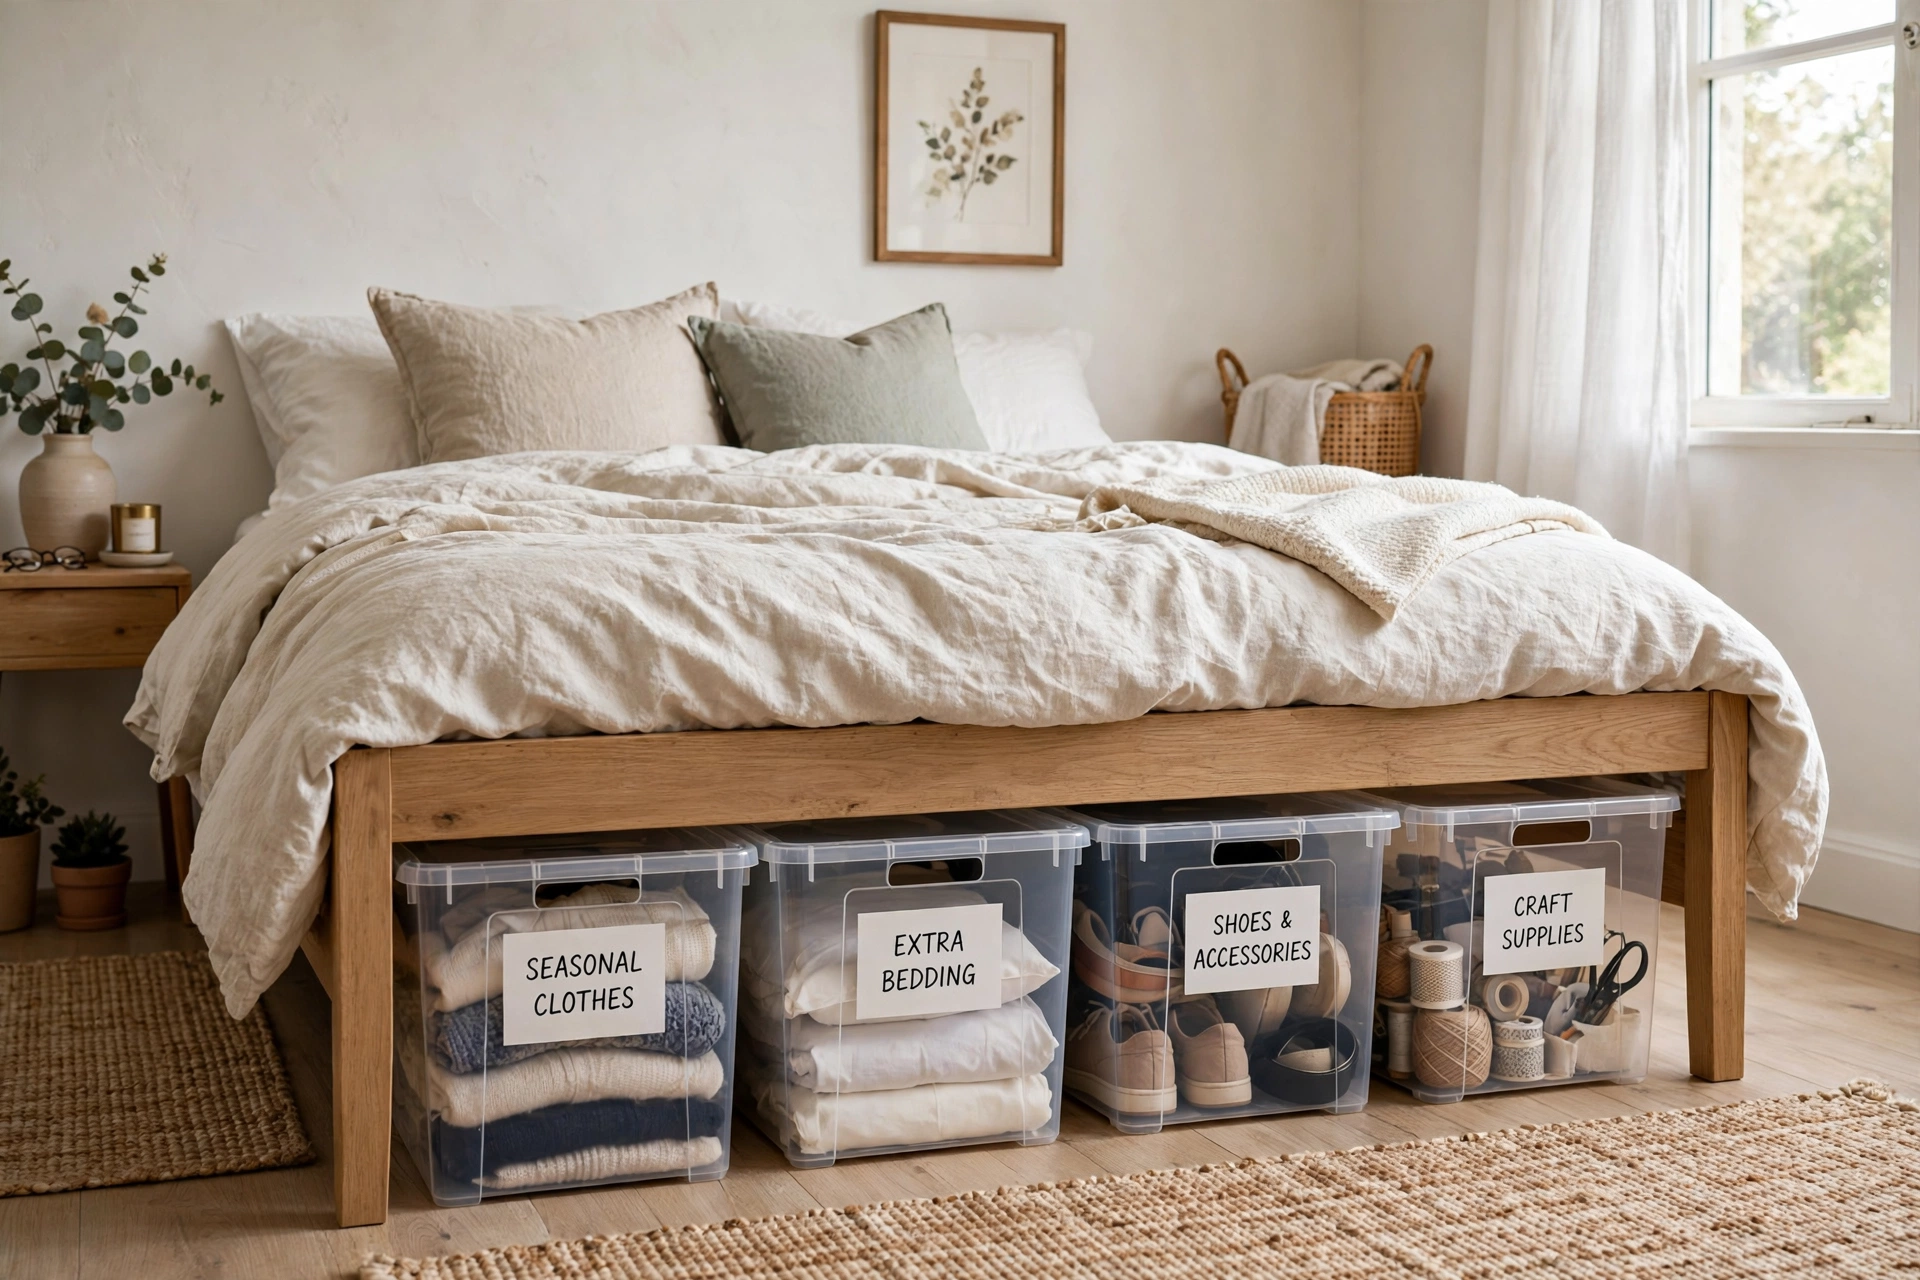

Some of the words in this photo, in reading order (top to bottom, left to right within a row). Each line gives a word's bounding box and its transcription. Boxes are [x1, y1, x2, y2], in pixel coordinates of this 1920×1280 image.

[1514, 892, 1574, 917] CRAFT
[1213, 910, 1272, 936] SHOES
[1280, 909, 1293, 929] &
[1502, 922, 1584, 950] SUPPLIES
[894, 929, 964, 957] EXTRA
[1193, 939, 1312, 970] ACCESSORIES
[525, 950, 643, 981] SEASONAL
[882, 963, 976, 993] BEDDING
[533, 985, 634, 1017] CLOTHES
